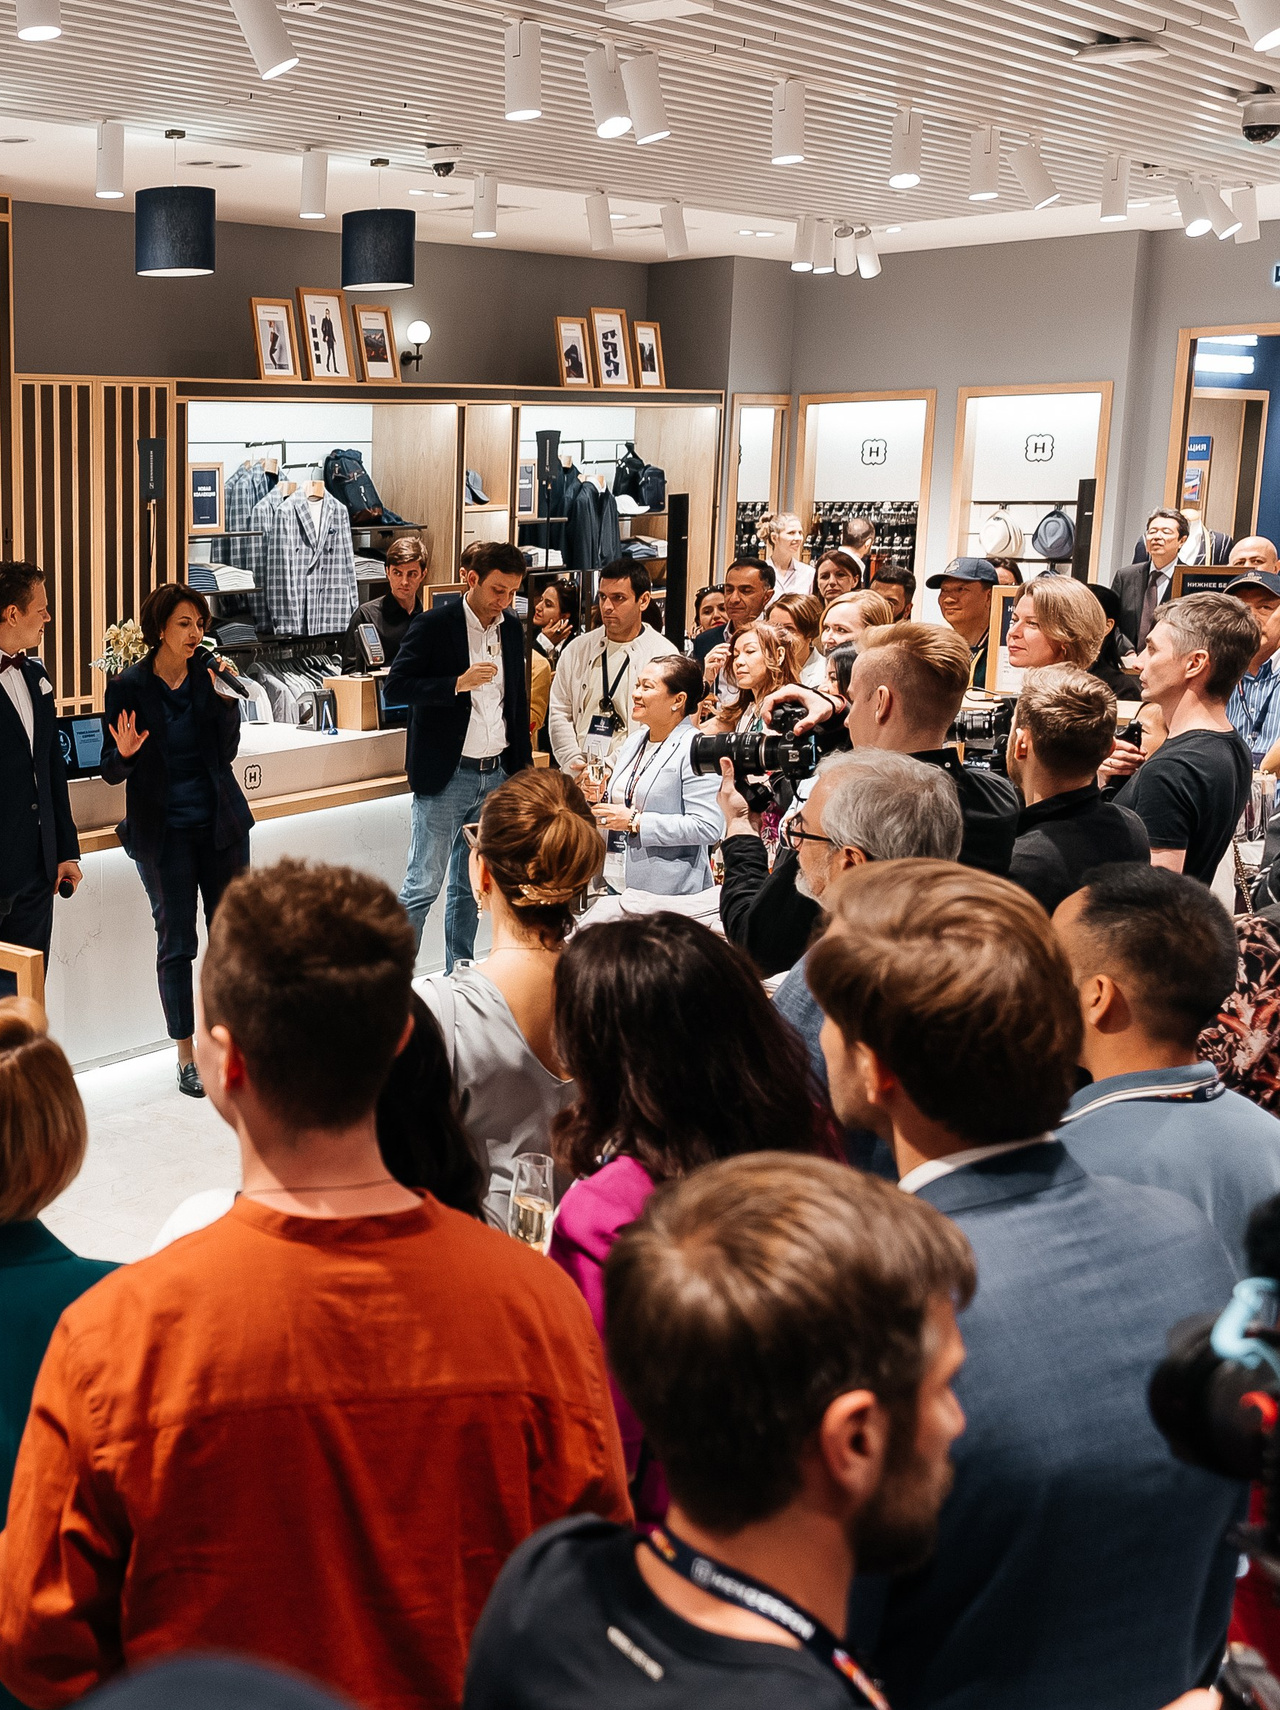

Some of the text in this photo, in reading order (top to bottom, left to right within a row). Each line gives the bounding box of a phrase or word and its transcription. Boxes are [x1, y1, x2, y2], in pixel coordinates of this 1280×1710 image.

[869, 446, 879, 457] H
[1034, 442, 1046, 453] H
[249, 772, 257, 783] H
